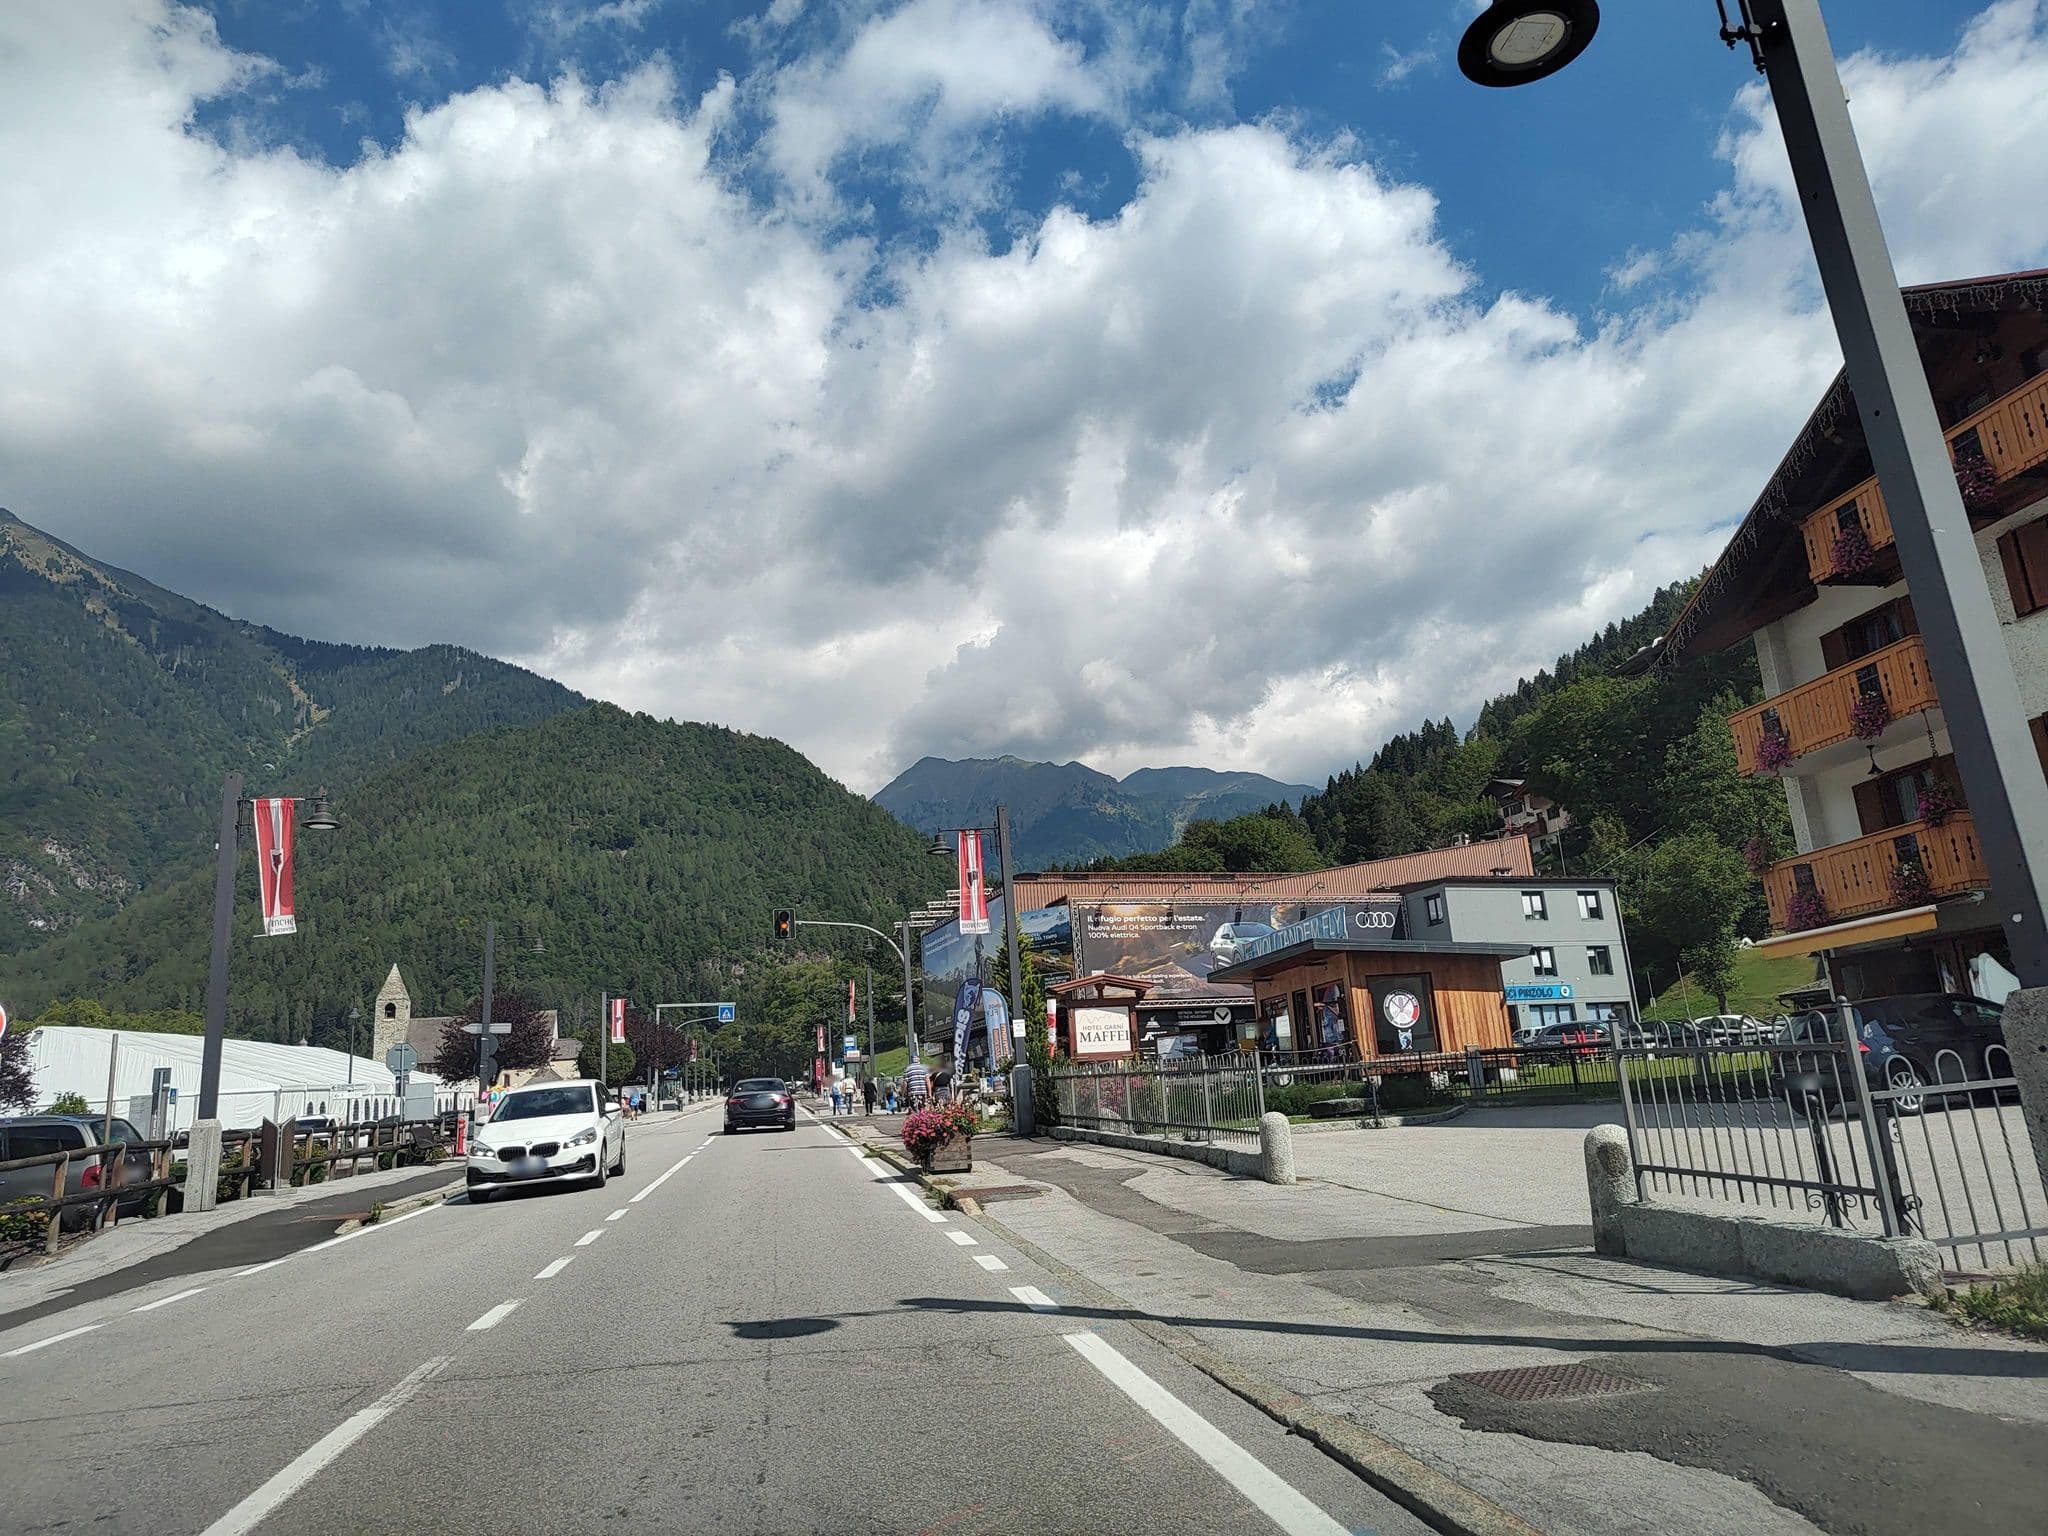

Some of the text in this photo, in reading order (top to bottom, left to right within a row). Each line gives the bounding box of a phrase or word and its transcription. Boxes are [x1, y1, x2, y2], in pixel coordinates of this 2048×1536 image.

[1123, 915, 1157, 924] perfetto
[1140, 923, 1176, 932] Sportback
[1279, 918, 1319, 948] TANDEM
[1321, 910, 1341, 936] FLY
[1518, 987, 1554, 998] PINZOLO
[1080, 1030, 1129, 1043] MAFFEI
